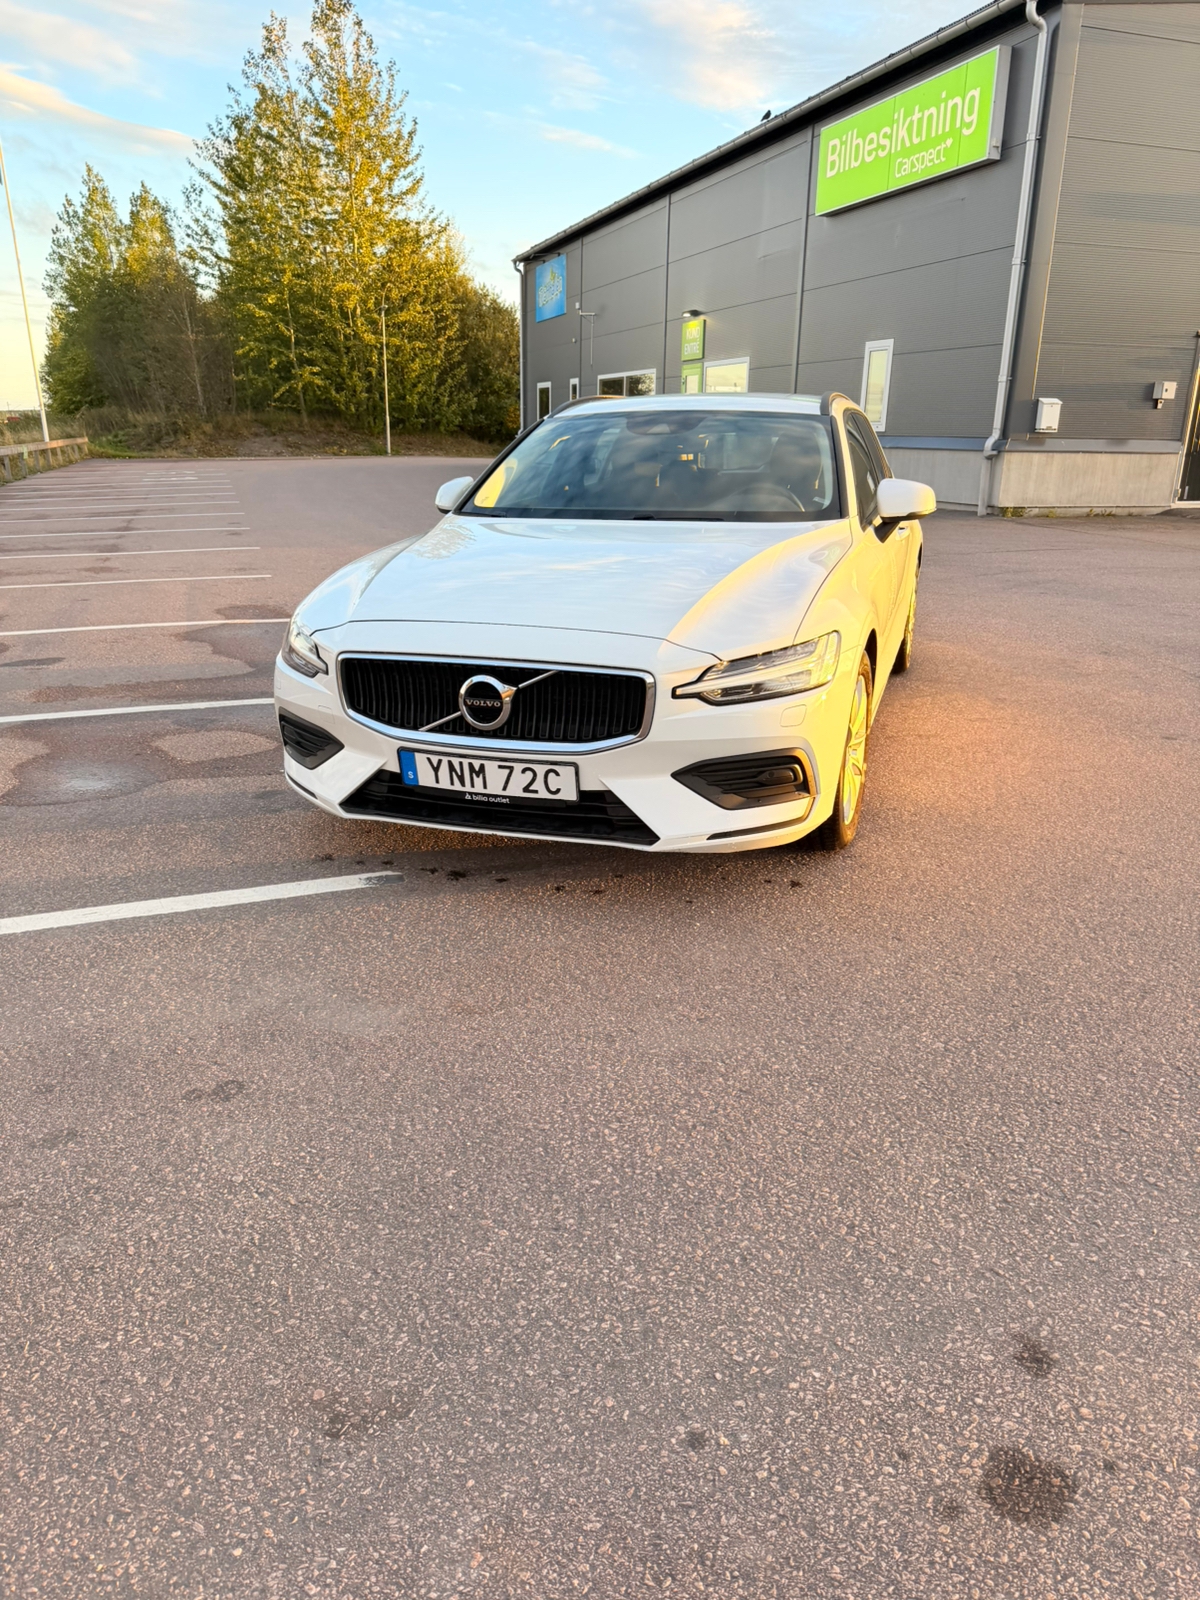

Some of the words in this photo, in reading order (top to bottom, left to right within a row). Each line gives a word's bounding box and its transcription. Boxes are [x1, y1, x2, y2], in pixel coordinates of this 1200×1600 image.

[826, 87, 981, 178] Bilbesiktning
[686, 326, 700, 340] KUND
[684, 338, 700, 355] ENTRÉ
[465, 699, 501, 707] VOLVO
[407, 771, 414, 779] S
[426, 757, 488, 790] YNM
[497, 764, 562, 796] 72C
[489, 796, 510, 804] outlet
